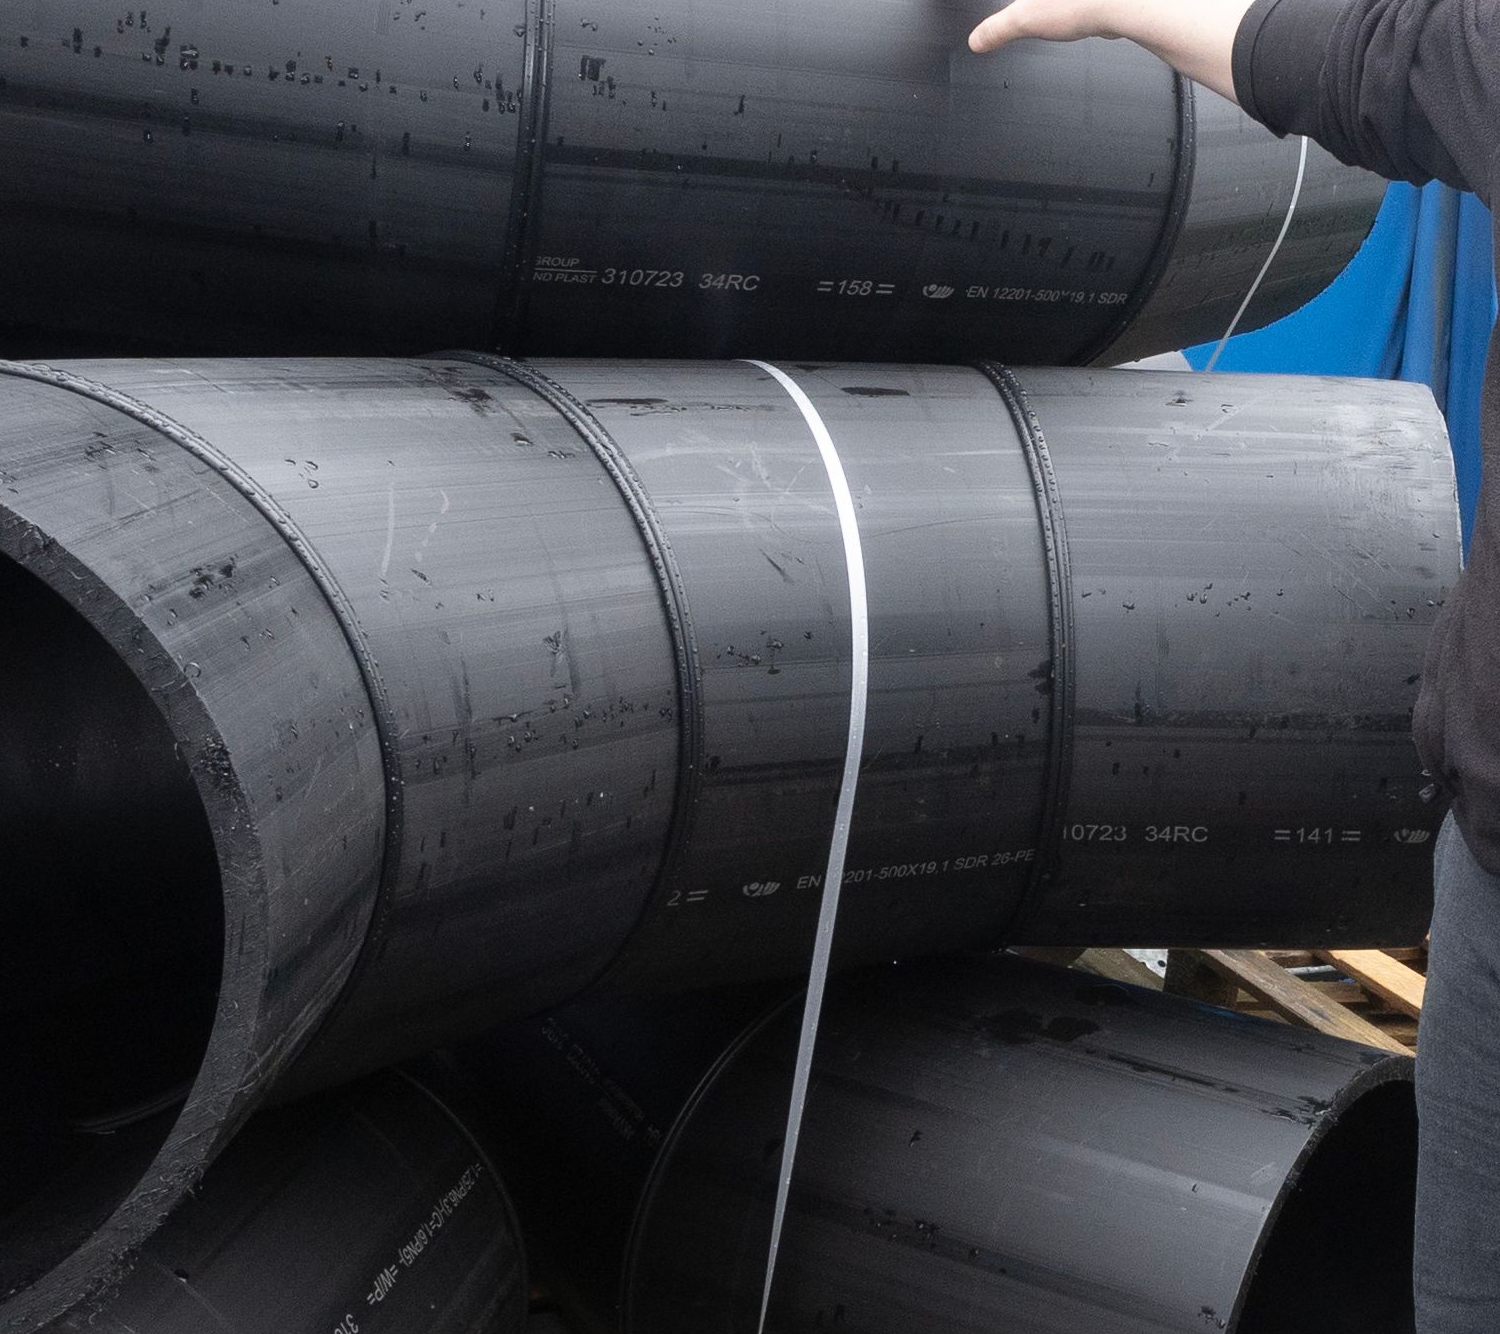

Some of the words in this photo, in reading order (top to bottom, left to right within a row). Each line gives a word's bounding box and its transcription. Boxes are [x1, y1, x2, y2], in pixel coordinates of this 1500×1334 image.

[554, 273, 598, 284] PLAST
[601, 267, 685, 288] 310723
[698, 272, 761, 292] 34RC
[966, 285, 988, 299] EN
[1097, 291, 1129, 305] SDR
[1143, 824, 1209, 843] 34RC
[796, 874, 822, 890] EN
[953, 854, 989, 870] SDR
